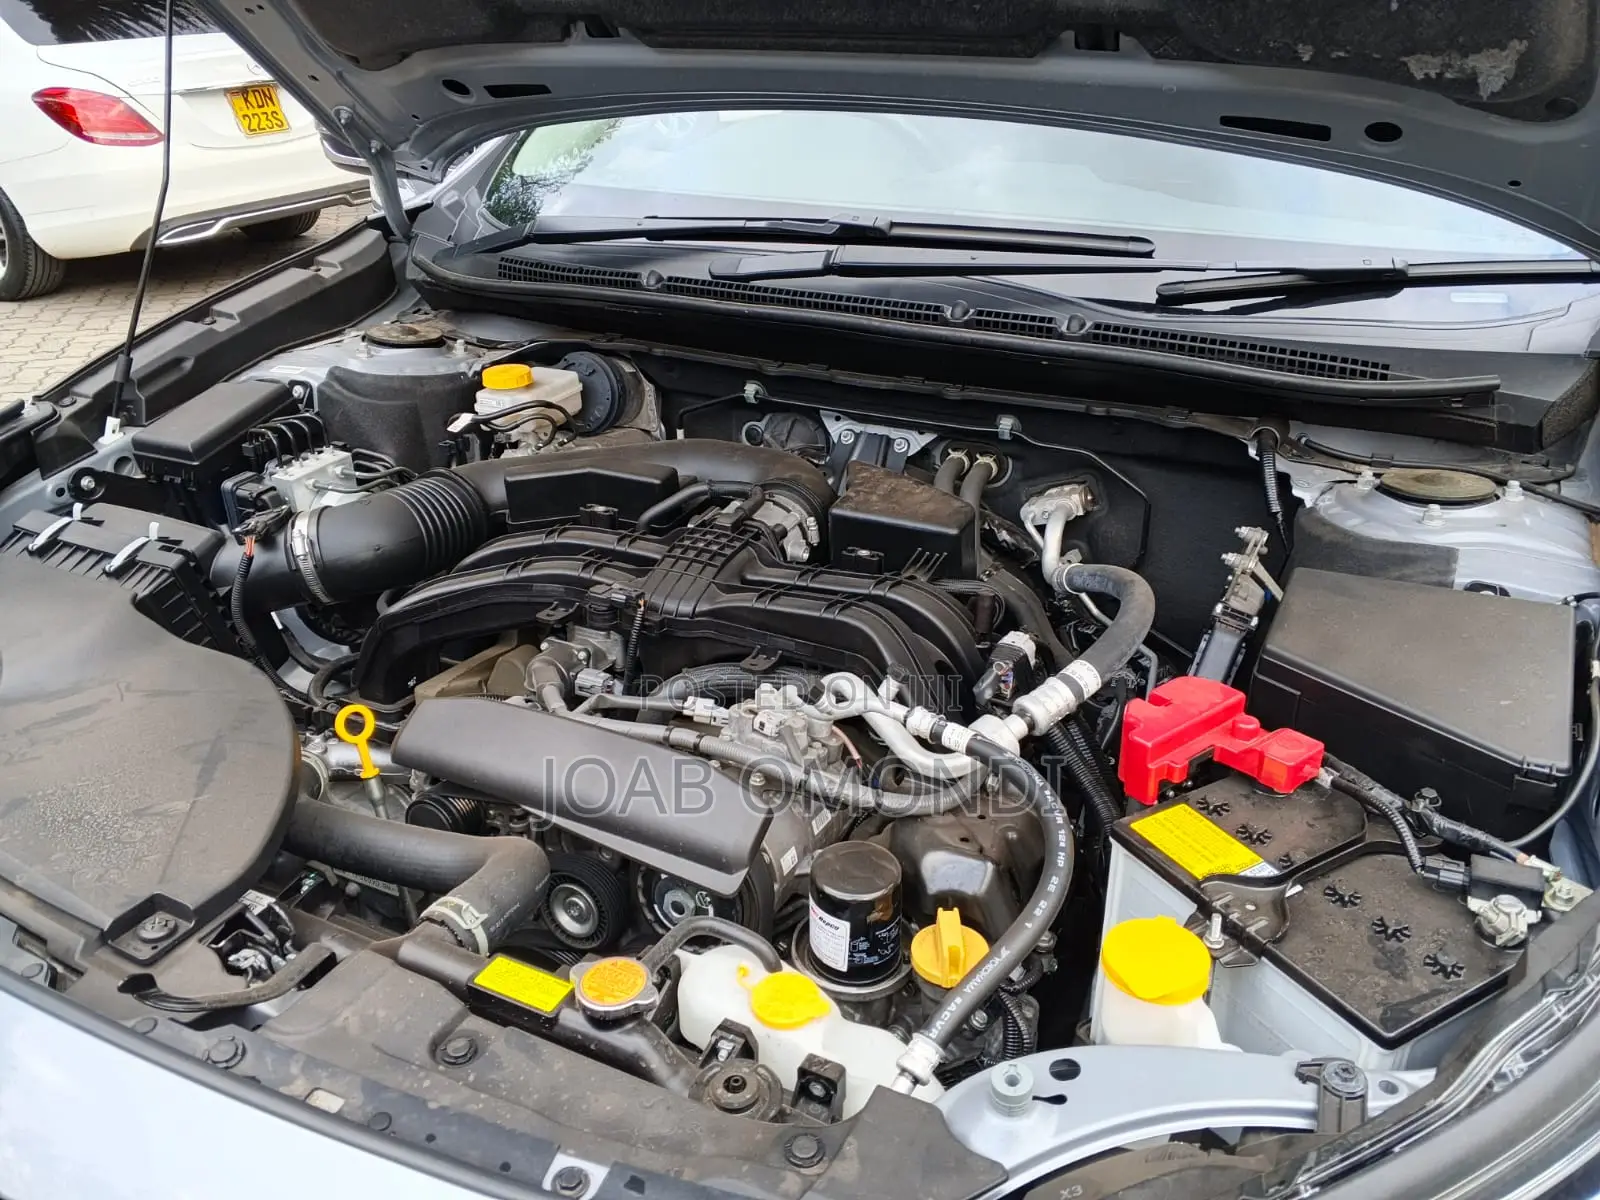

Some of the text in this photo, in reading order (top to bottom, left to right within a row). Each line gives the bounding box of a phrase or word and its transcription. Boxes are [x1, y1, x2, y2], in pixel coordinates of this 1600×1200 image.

[241, 88, 276, 110] KDN
[242, 111, 284, 132] 223S
[963, 956, 1001, 993] YOKOHAMA
